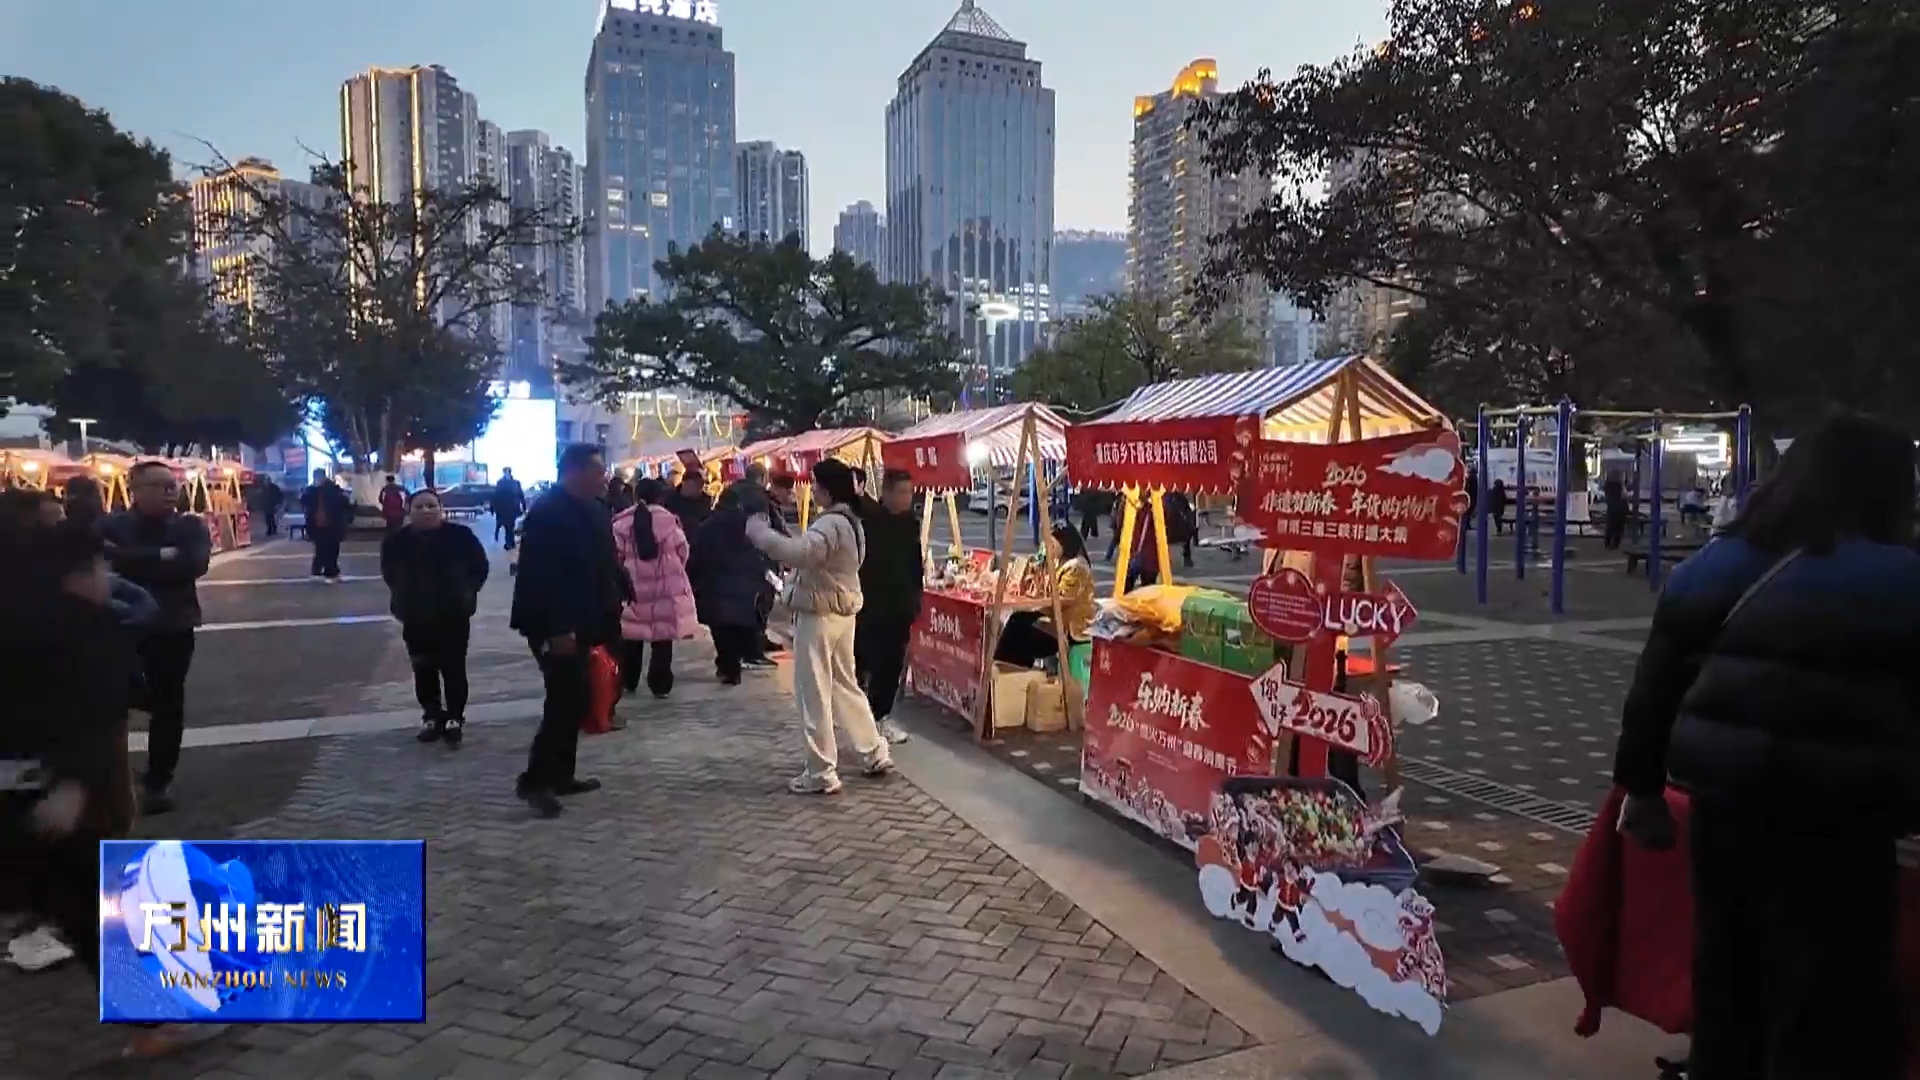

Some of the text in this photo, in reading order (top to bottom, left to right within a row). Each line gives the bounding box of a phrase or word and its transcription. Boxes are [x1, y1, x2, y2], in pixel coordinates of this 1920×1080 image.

[1322, 460, 1367, 488] 2026
[1325, 596, 1407, 634] LUCKY
[1259, 677, 1288, 724] 你好
[1291, 692, 1358, 743] 2026
